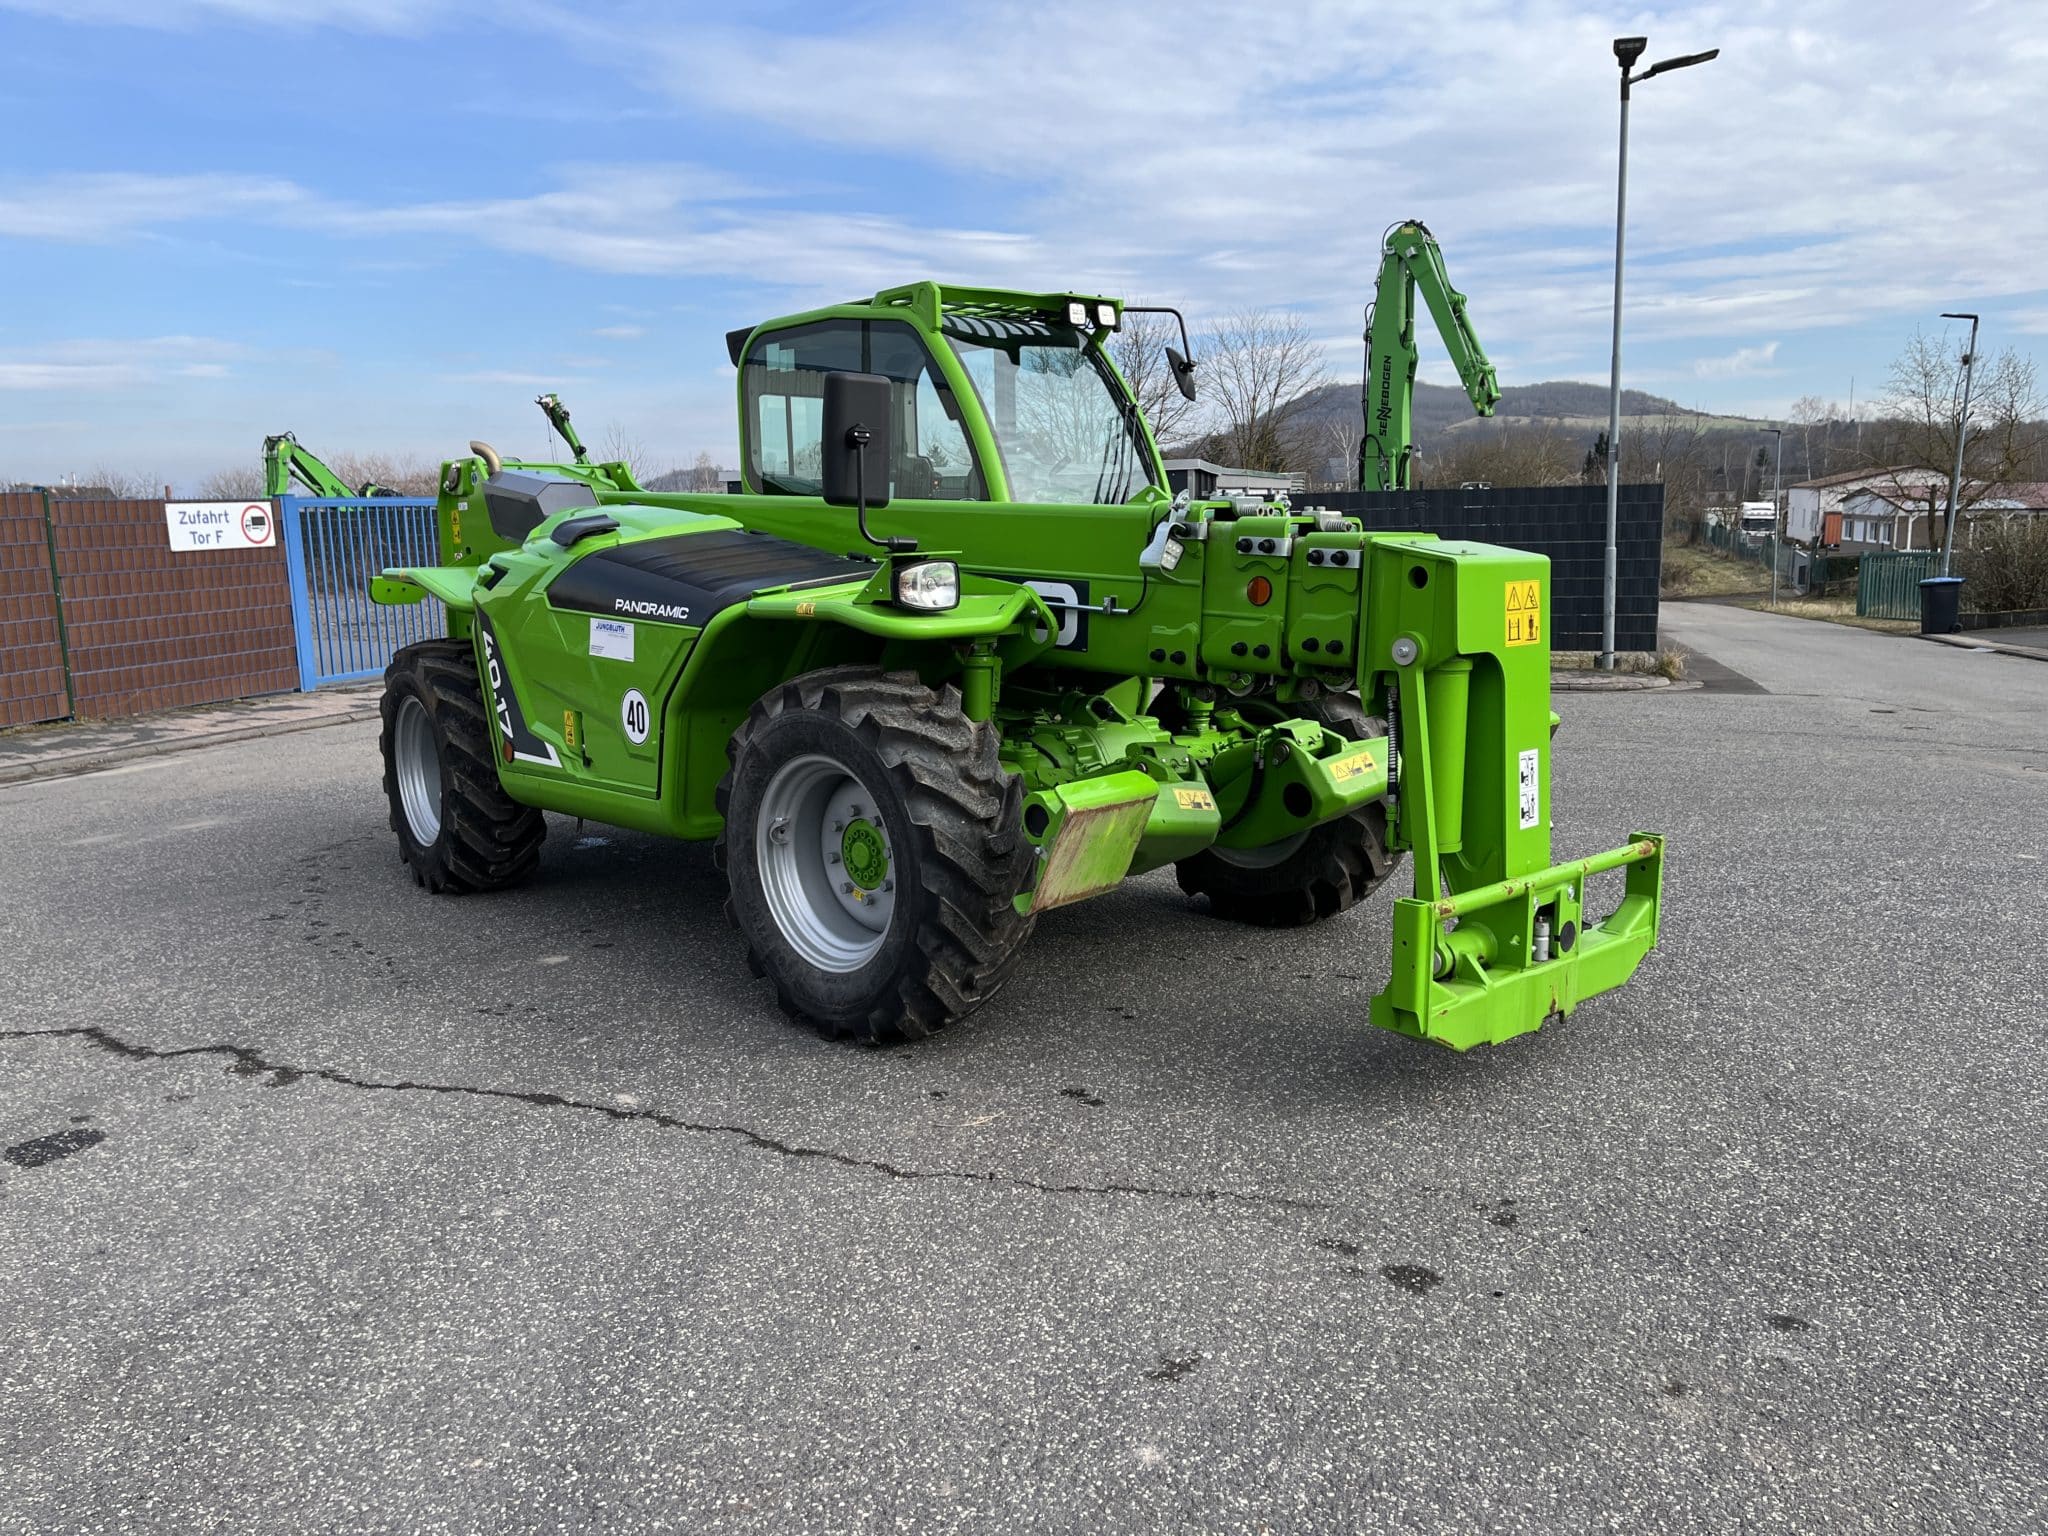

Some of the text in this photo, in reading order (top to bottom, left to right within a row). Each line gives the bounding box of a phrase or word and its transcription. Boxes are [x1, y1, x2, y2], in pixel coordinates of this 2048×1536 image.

[1376, 355, 1392, 437] SENNEBOGEN
[178, 509, 230, 525] Zufahrt
[189, 530, 223, 544] Tor F
[615, 598, 689, 619] PANORAMIC
[482, 630, 513, 739] 40.17
[627, 700, 645, 734] 40
